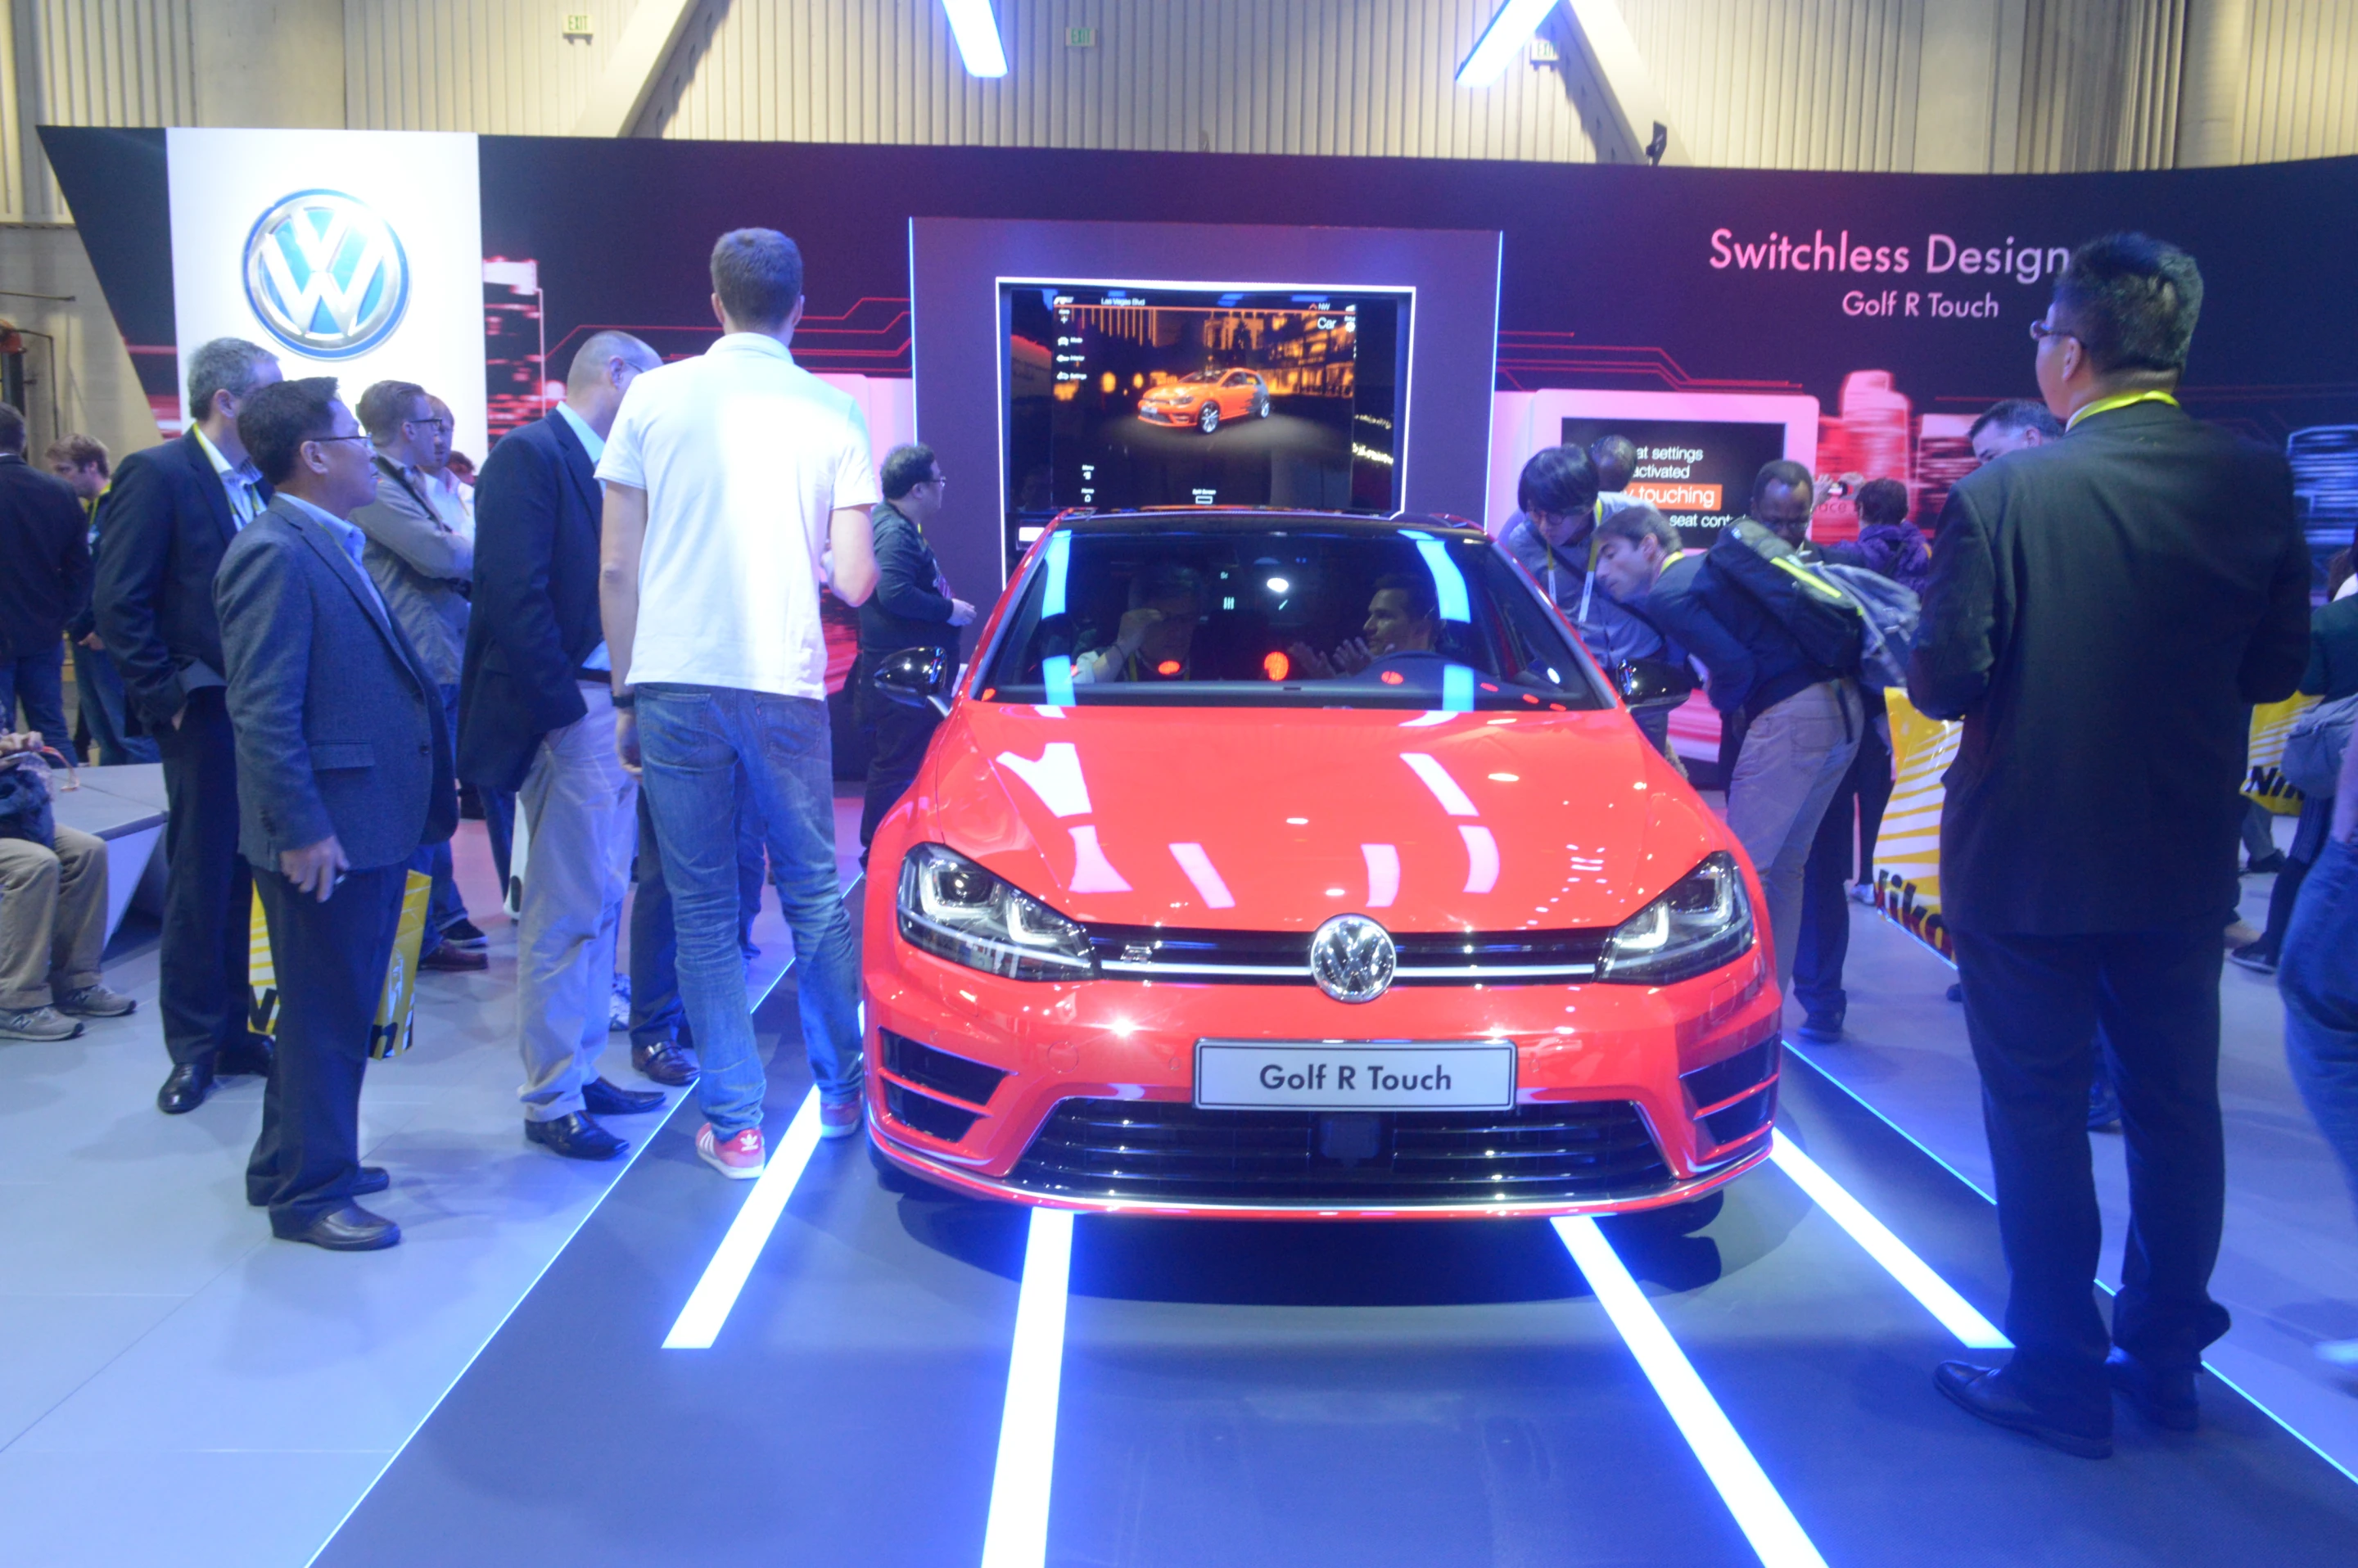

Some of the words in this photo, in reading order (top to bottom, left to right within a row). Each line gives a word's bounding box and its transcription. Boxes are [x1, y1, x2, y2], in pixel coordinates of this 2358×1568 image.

[568, 15, 589, 30] EXIT
[1071, 28, 1091, 45] EXIT
[1710, 228, 1909, 273] Switchless
[1927, 233, 2070, 284] Design
[1100, 297, 1112, 305] Las
[1113, 298, 1131, 307] Vegas
[1842, 290, 1897, 316] Golf
[1904, 292, 1920, 317] R
[1927, 291, 1999, 318] Touch
[1317, 316, 1337, 329] Car
[1651, 445, 1704, 463] settings
[1638, 486, 1715, 508] touching
[1669, 513, 1698, 527] seat
[1701, 513, 1746, 528] cont
[1259, 1064, 1327, 1090] Golf
[1338, 1065, 1356, 1090] R
[1367, 1064, 1452, 1091] Touch
